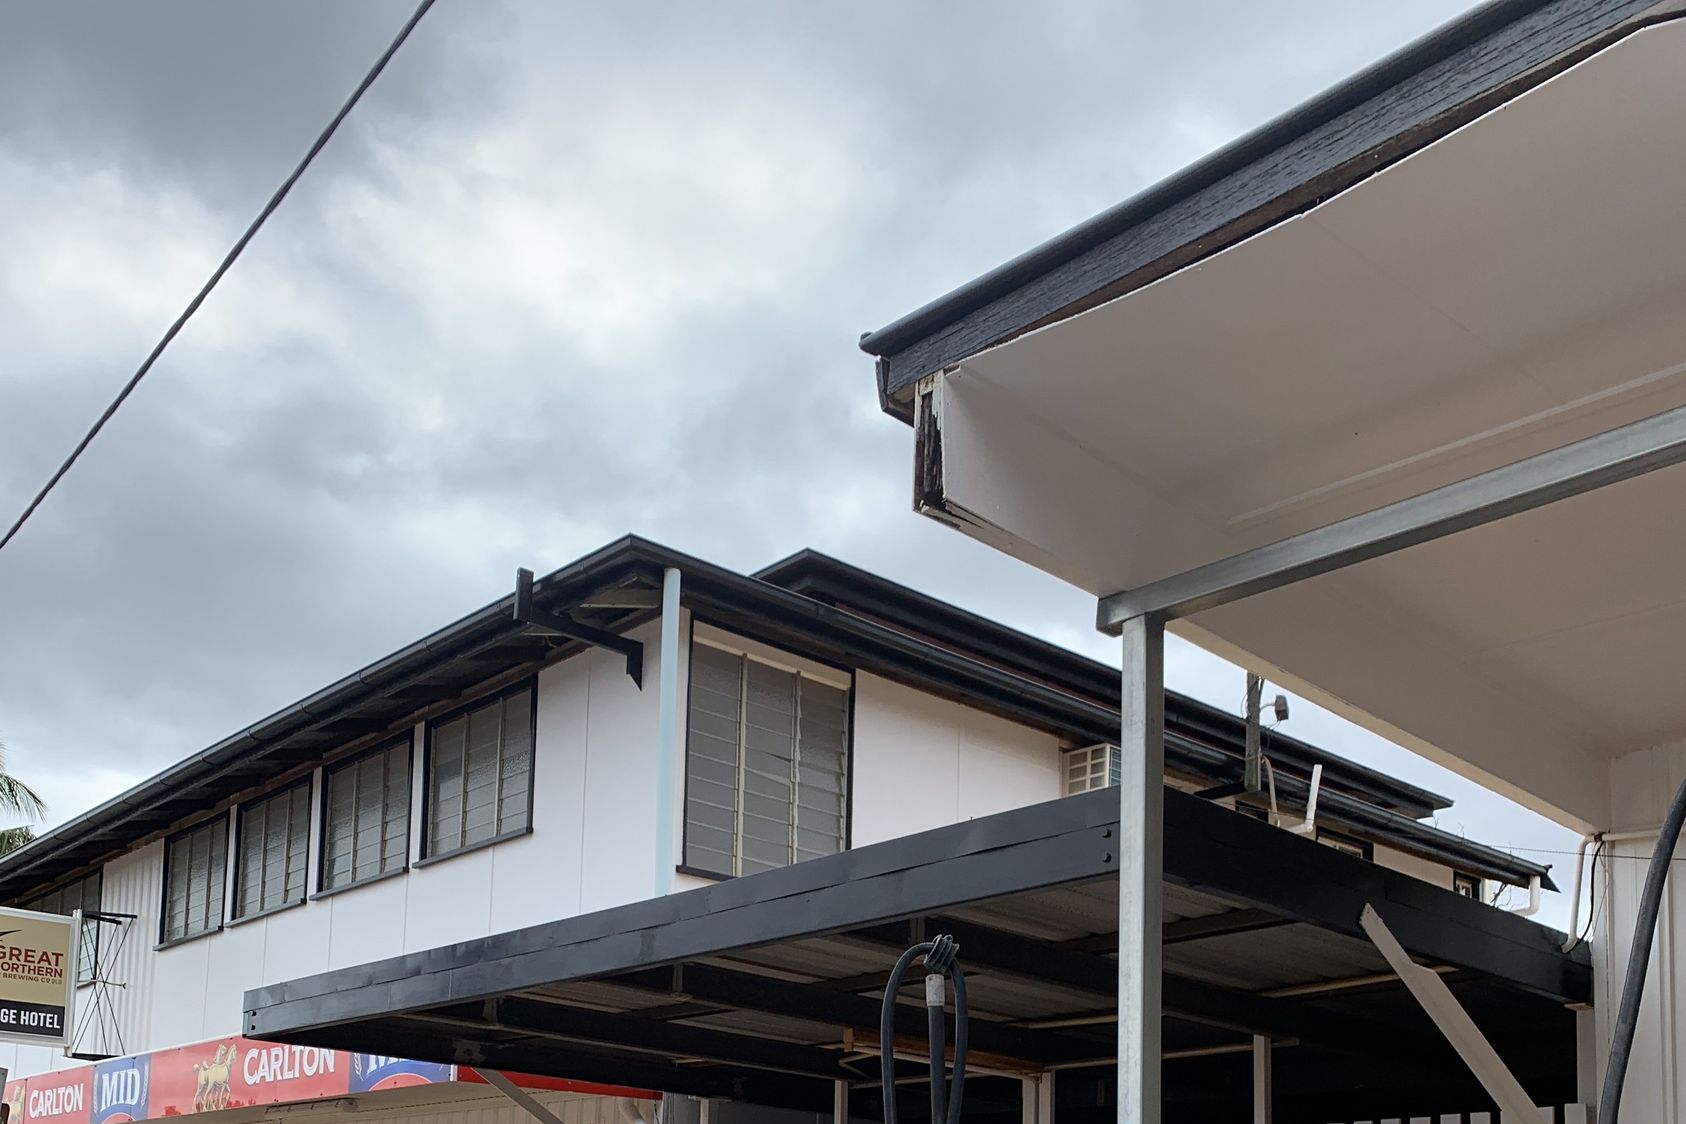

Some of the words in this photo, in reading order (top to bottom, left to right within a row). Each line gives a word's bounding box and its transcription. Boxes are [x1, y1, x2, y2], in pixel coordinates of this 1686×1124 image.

[0, 961, 63, 978] ORTHERN
[20, 1010, 60, 1029] HOTEL
[243, 1045, 335, 1085] CARLTON
[29, 1083, 84, 1119] CARLTON
[100, 1068, 141, 1113] MID
